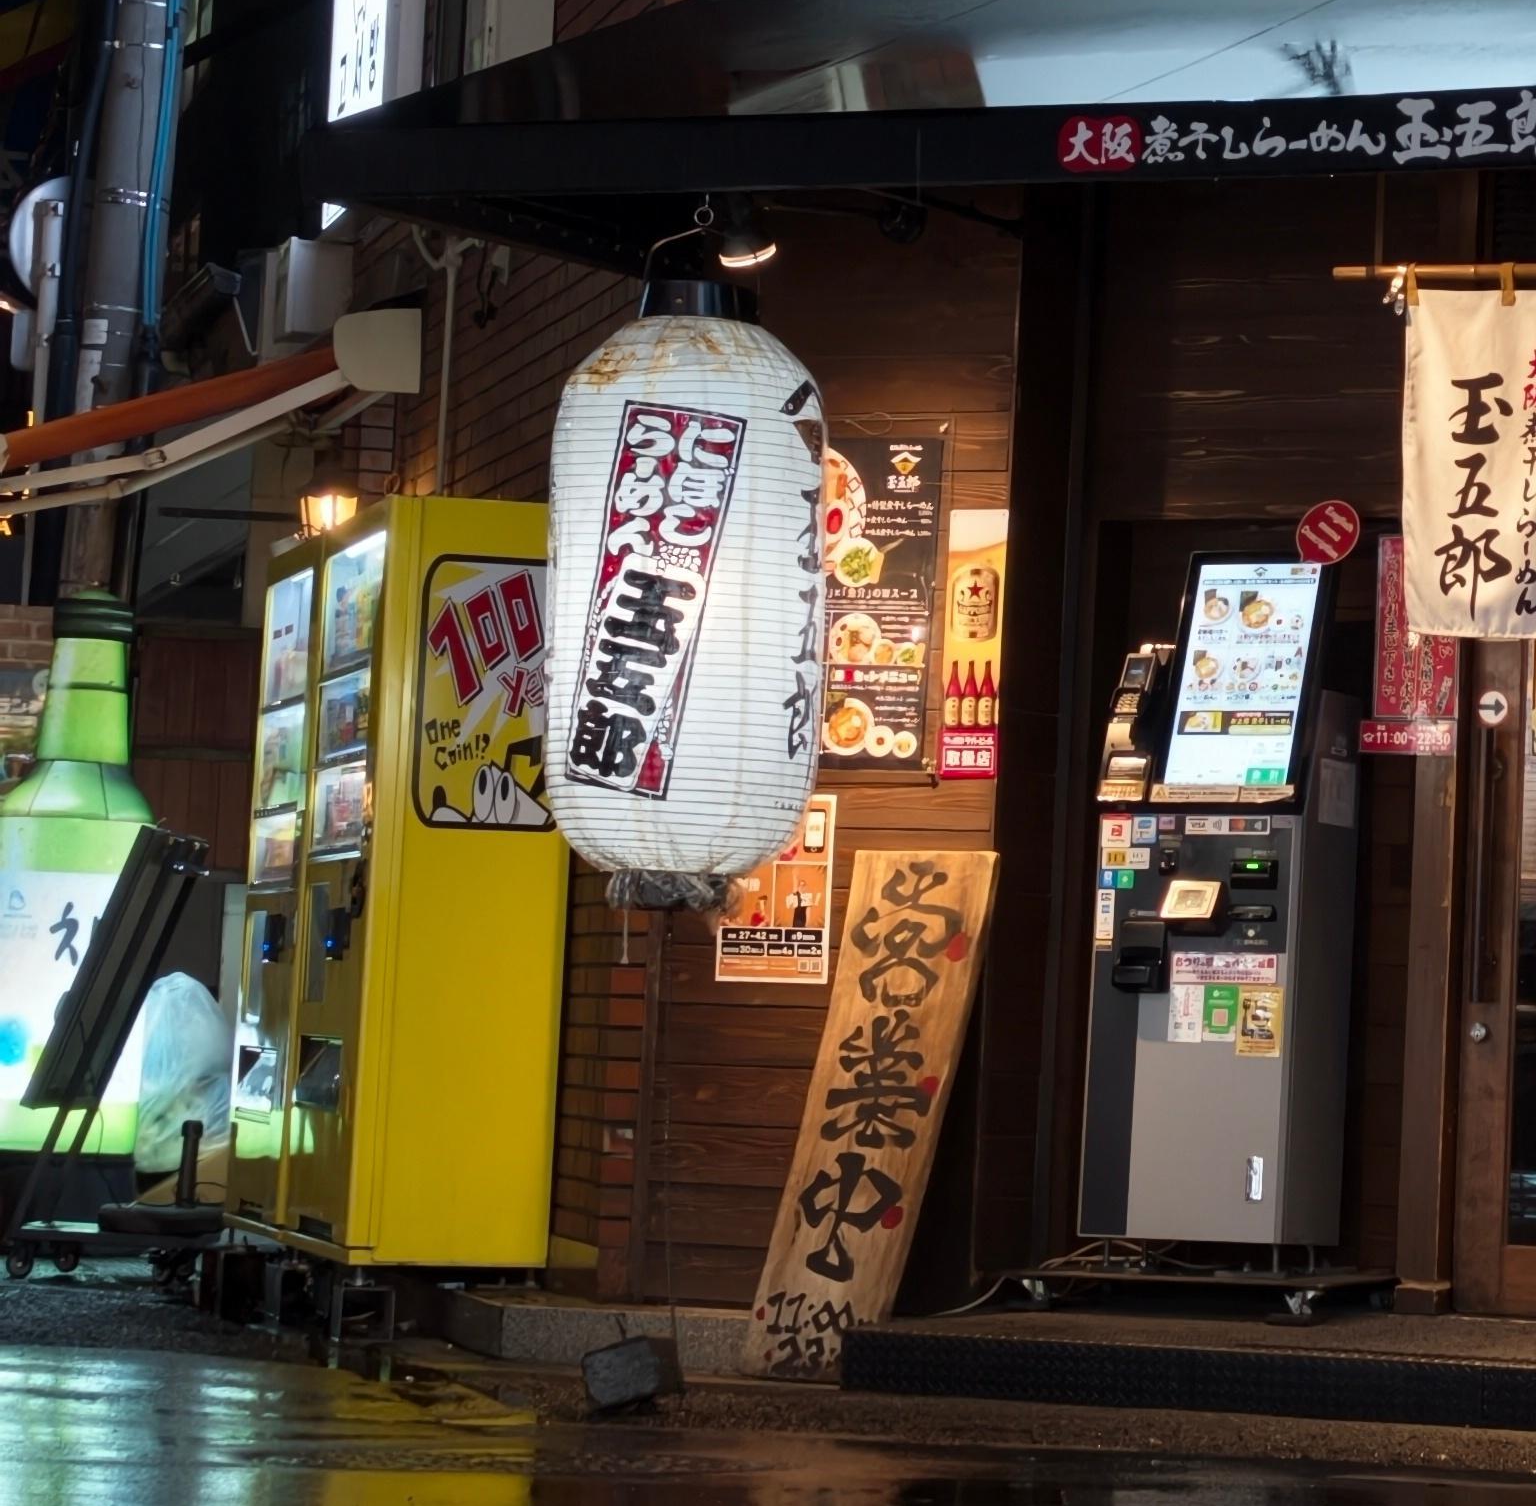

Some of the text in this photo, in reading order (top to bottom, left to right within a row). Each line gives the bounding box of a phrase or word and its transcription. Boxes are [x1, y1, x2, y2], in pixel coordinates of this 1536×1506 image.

[1434, 372, 1515, 622] 玉五郎
[428, 569, 545, 707] 100
[569, 568, 697, 777] 玉五郎
[425, 718, 462, 745] One
[434, 733, 492, 772] Coin!?
